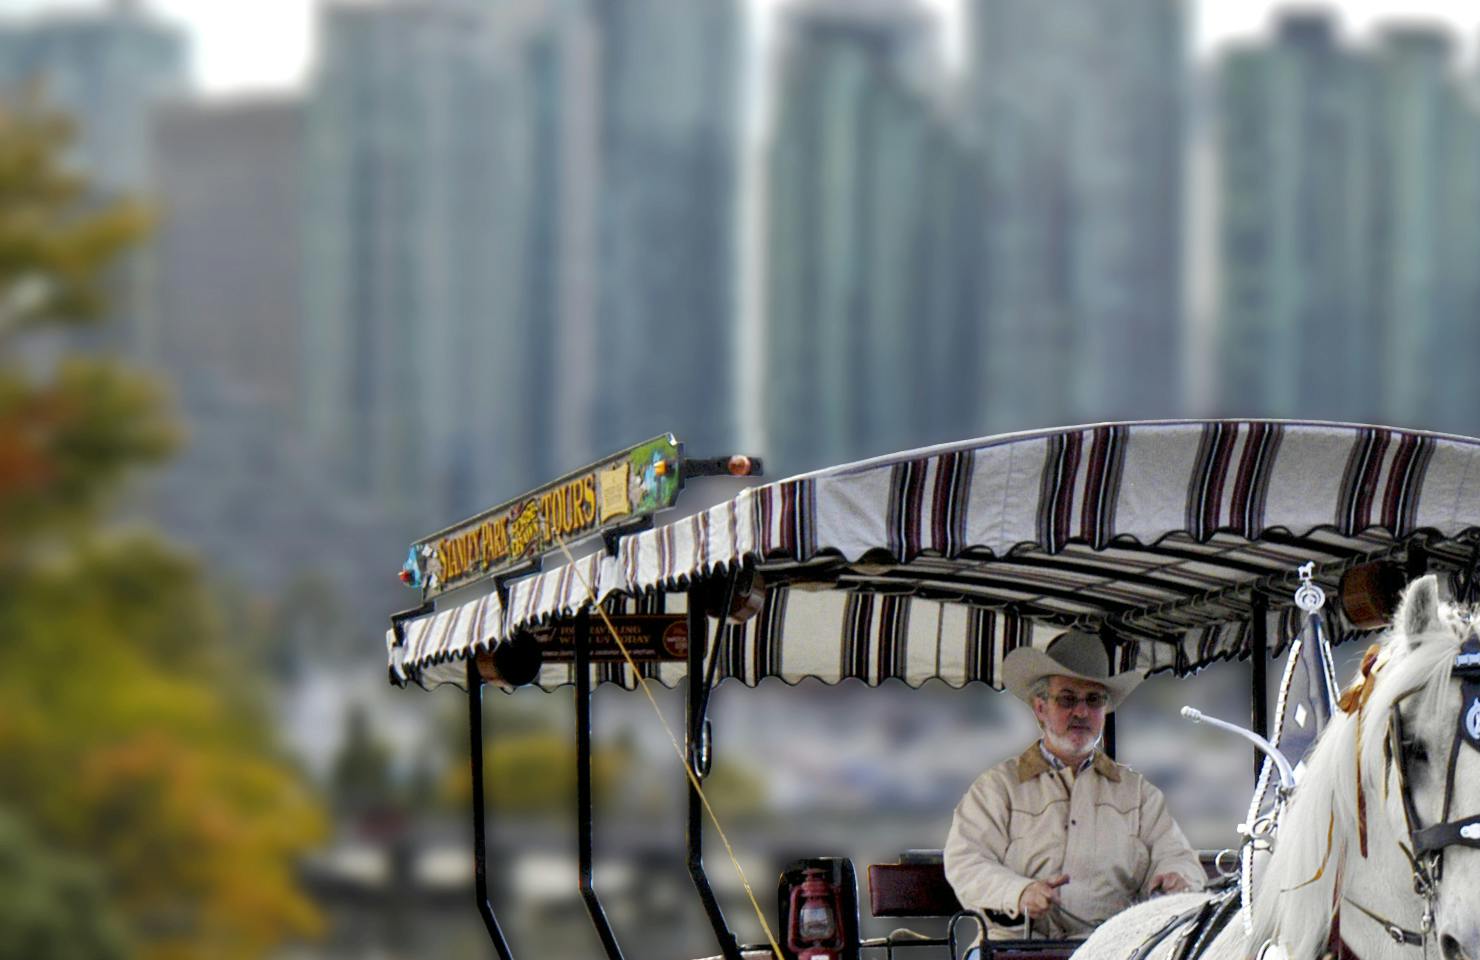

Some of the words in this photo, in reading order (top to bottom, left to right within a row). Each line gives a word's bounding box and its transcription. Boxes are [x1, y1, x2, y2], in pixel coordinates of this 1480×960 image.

[438, 528, 481, 582] STANLEY
[481, 515, 509, 569] PARK
[541, 474, 596, 541] TOURS
